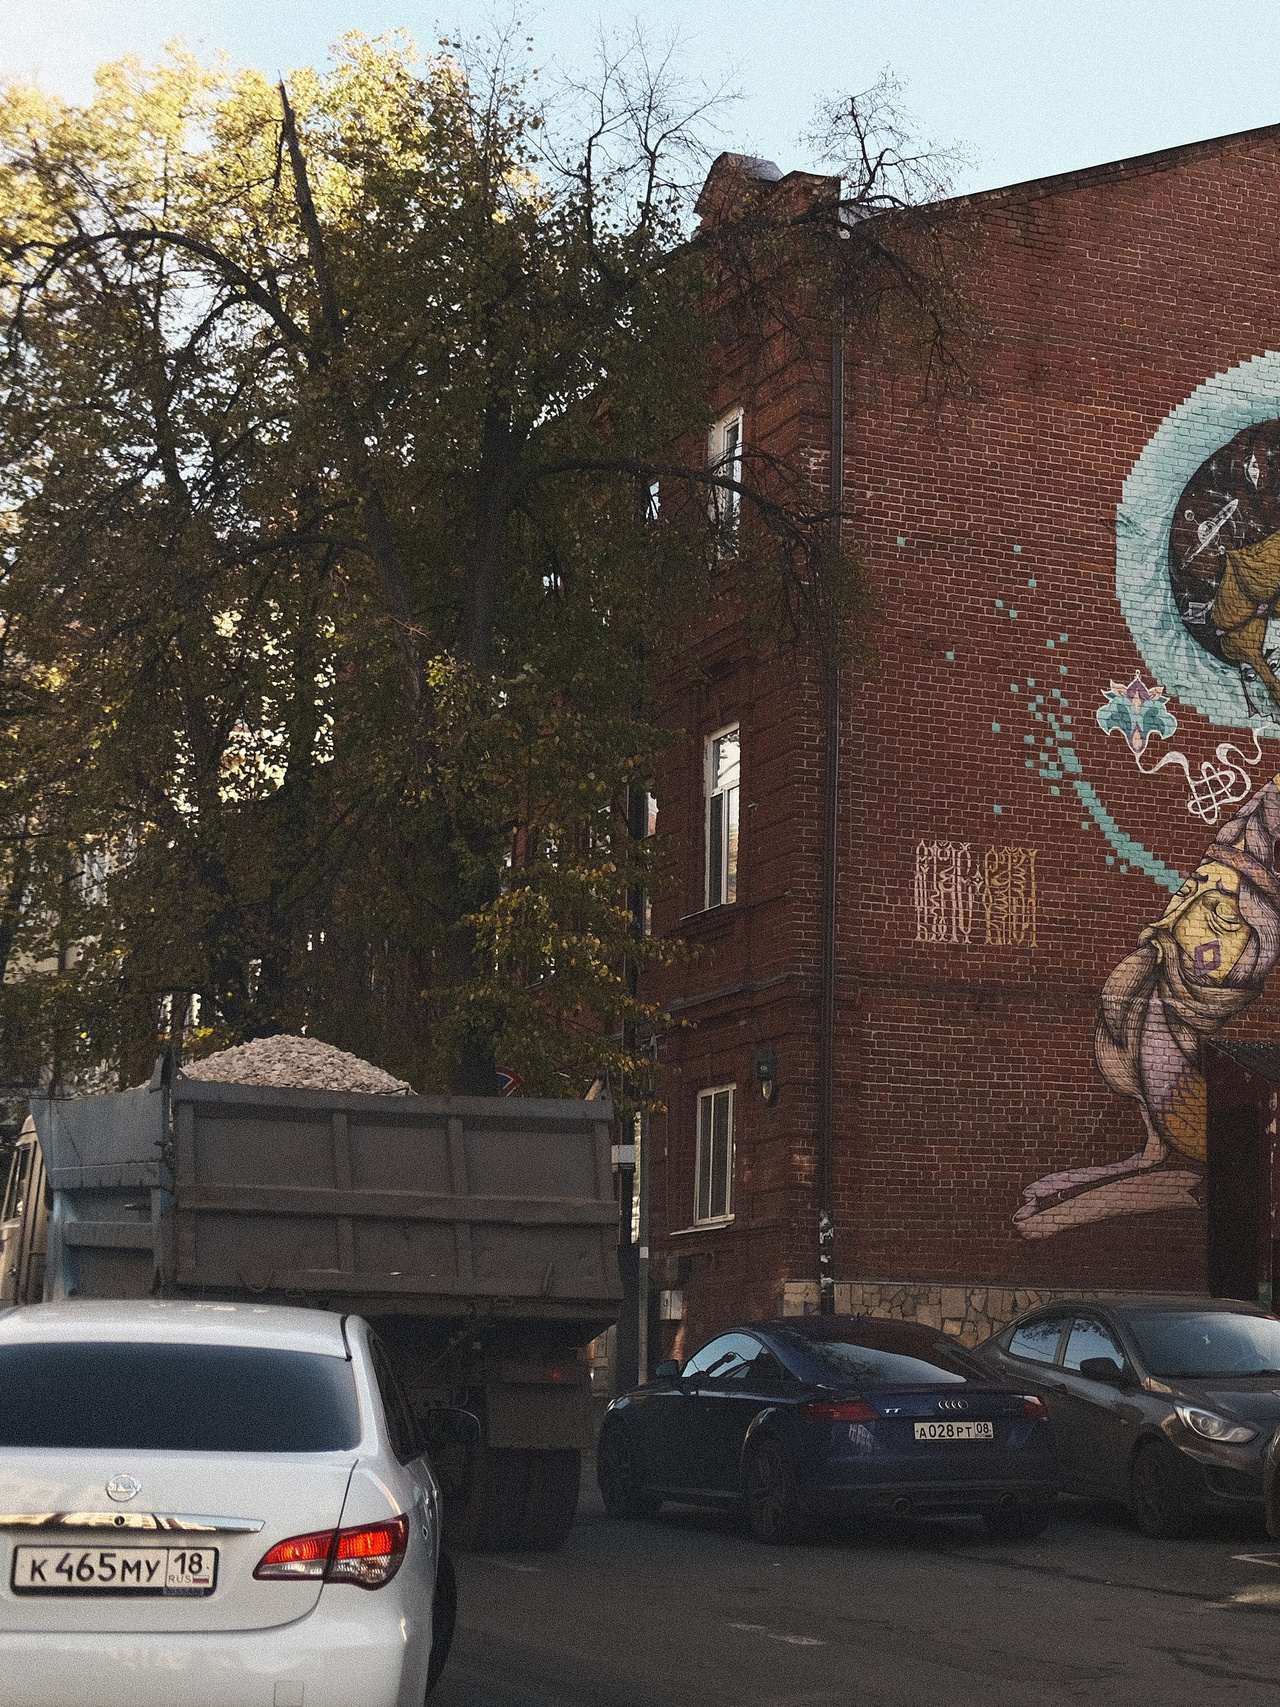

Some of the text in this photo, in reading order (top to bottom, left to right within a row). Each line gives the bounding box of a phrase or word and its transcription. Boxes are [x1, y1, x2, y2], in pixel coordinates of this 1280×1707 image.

[976, 1423, 989, 1434] 08
[174, 1552, 203, 1575] 18
[168, 1575, 192, 1584] RUS
